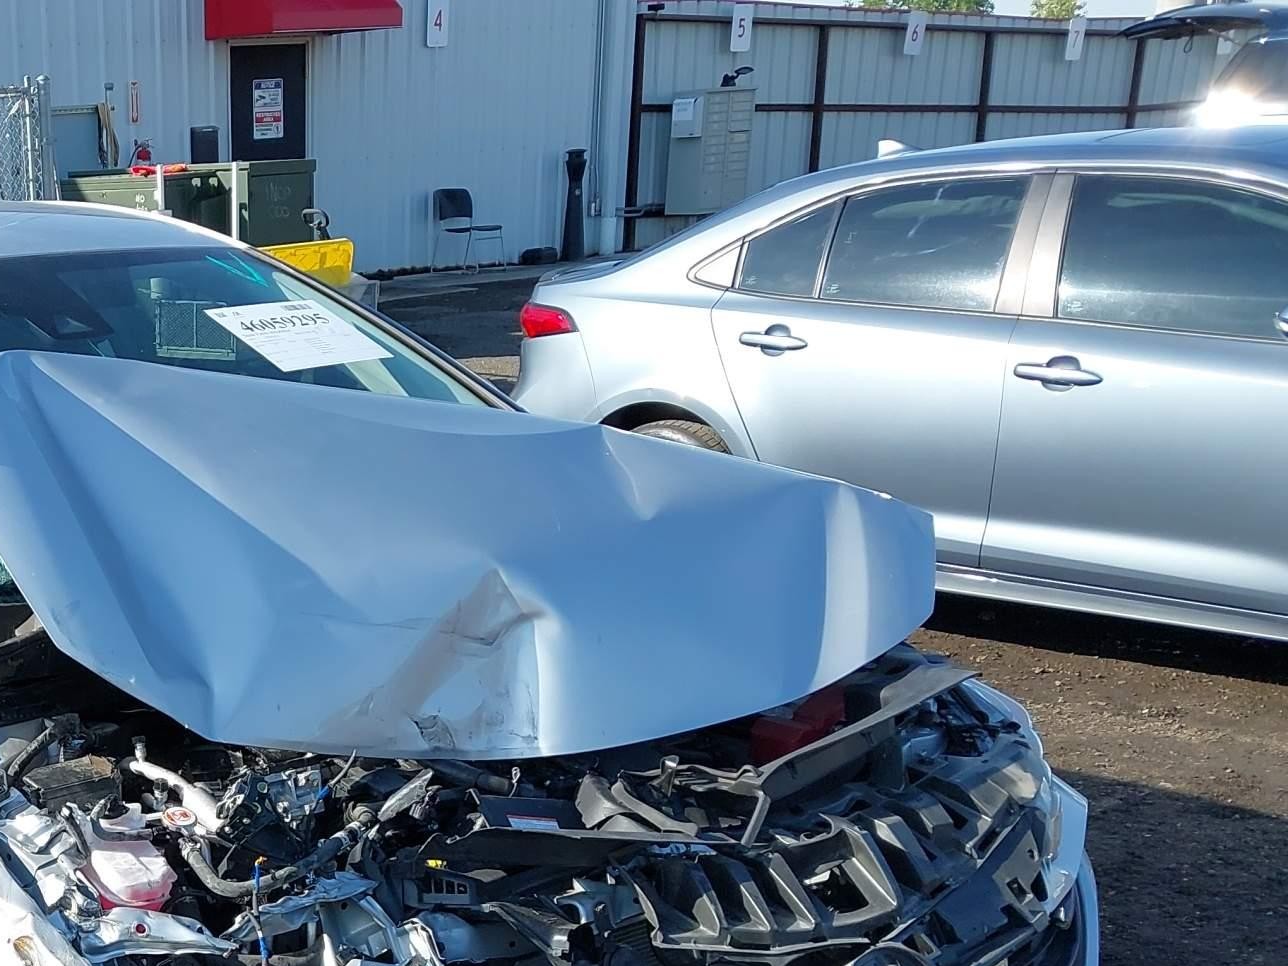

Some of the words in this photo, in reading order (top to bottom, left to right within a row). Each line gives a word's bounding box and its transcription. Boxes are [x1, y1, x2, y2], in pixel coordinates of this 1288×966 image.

[433, 9, 443, 31] 4
[737, 17, 746, 38] 5
[911, 23, 919, 42] 6
[1072, 30, 1081, 49] 7
[239, 312, 330, 332] 46059295
